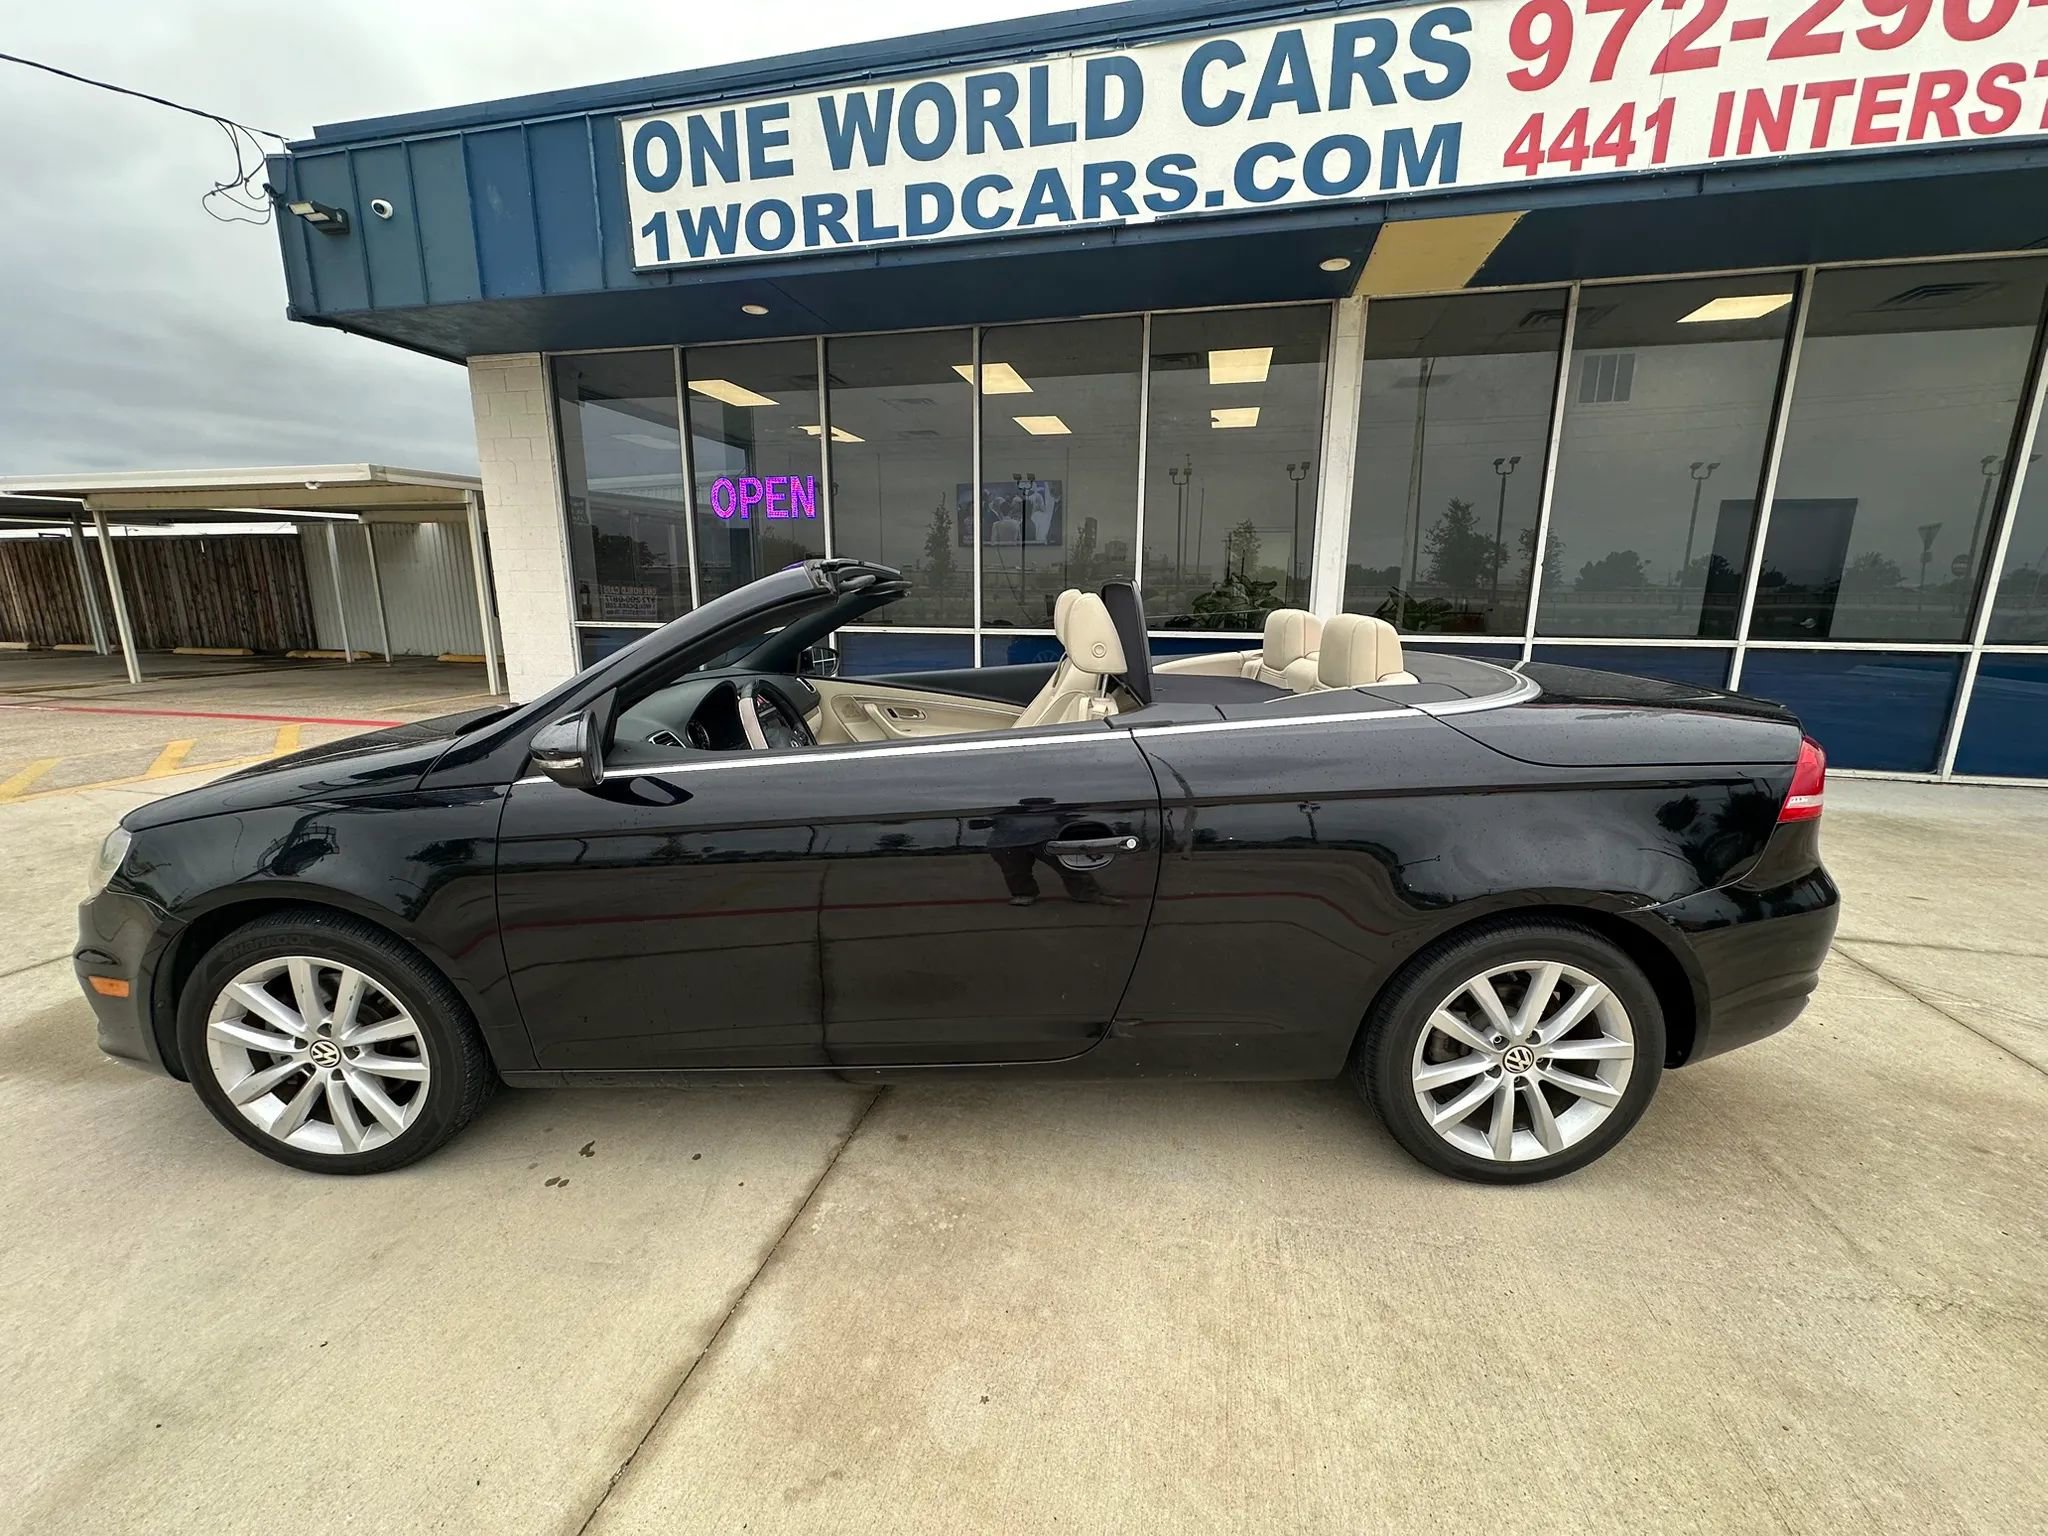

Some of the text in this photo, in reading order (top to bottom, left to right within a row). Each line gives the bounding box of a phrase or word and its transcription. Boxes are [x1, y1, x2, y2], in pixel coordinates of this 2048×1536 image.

[632, 7, 1473, 193] ONE WORLD CARS
[1503, 97, 1677, 177] 4441
[641, 121, 1463, 262] 1WORLDCARS.COM
[710, 475, 817, 520] OPEN
